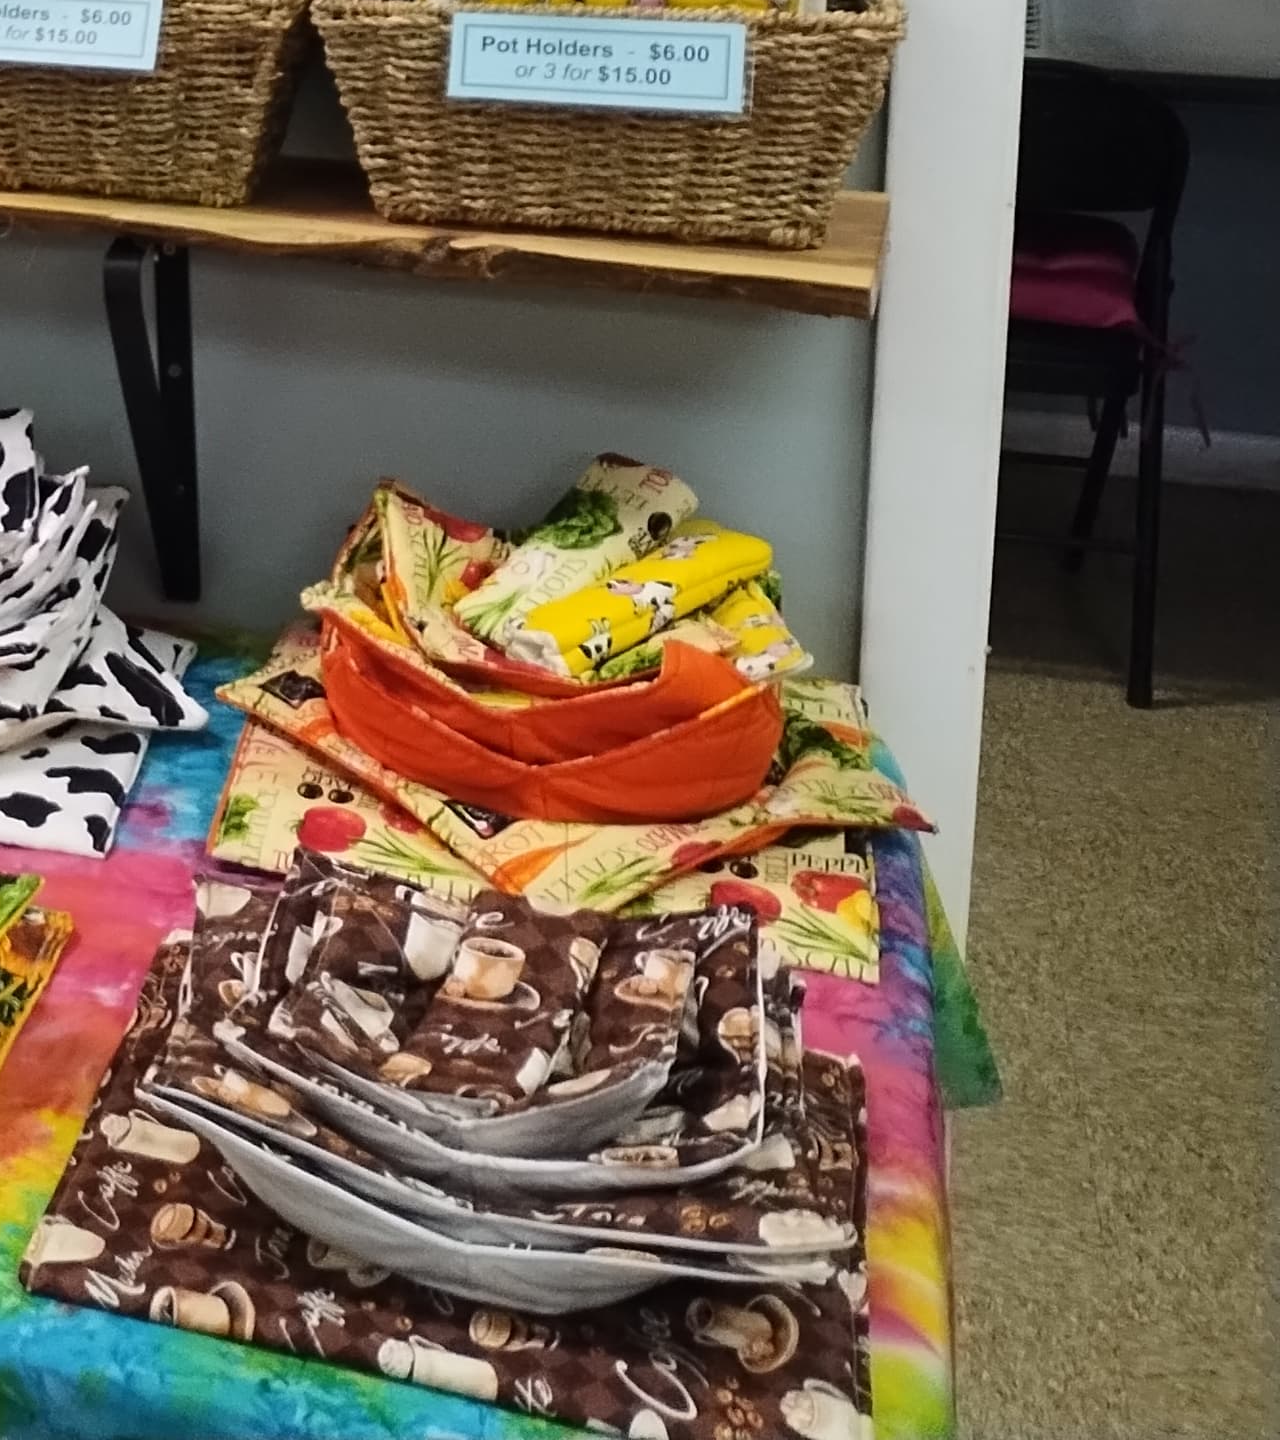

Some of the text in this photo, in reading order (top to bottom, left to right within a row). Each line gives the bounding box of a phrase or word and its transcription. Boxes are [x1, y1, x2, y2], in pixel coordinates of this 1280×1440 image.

[80, 8, 132, 26] $6.00
[5, 24, 32, 41] for
[34, 27, 98, 45] $15.00
[481, 35, 520, 53] Pot
[526, 37, 614, 58] Holders
[649, 42, 710, 63] $6.00
[515, 62, 671, 85] or 3 for $15.00
